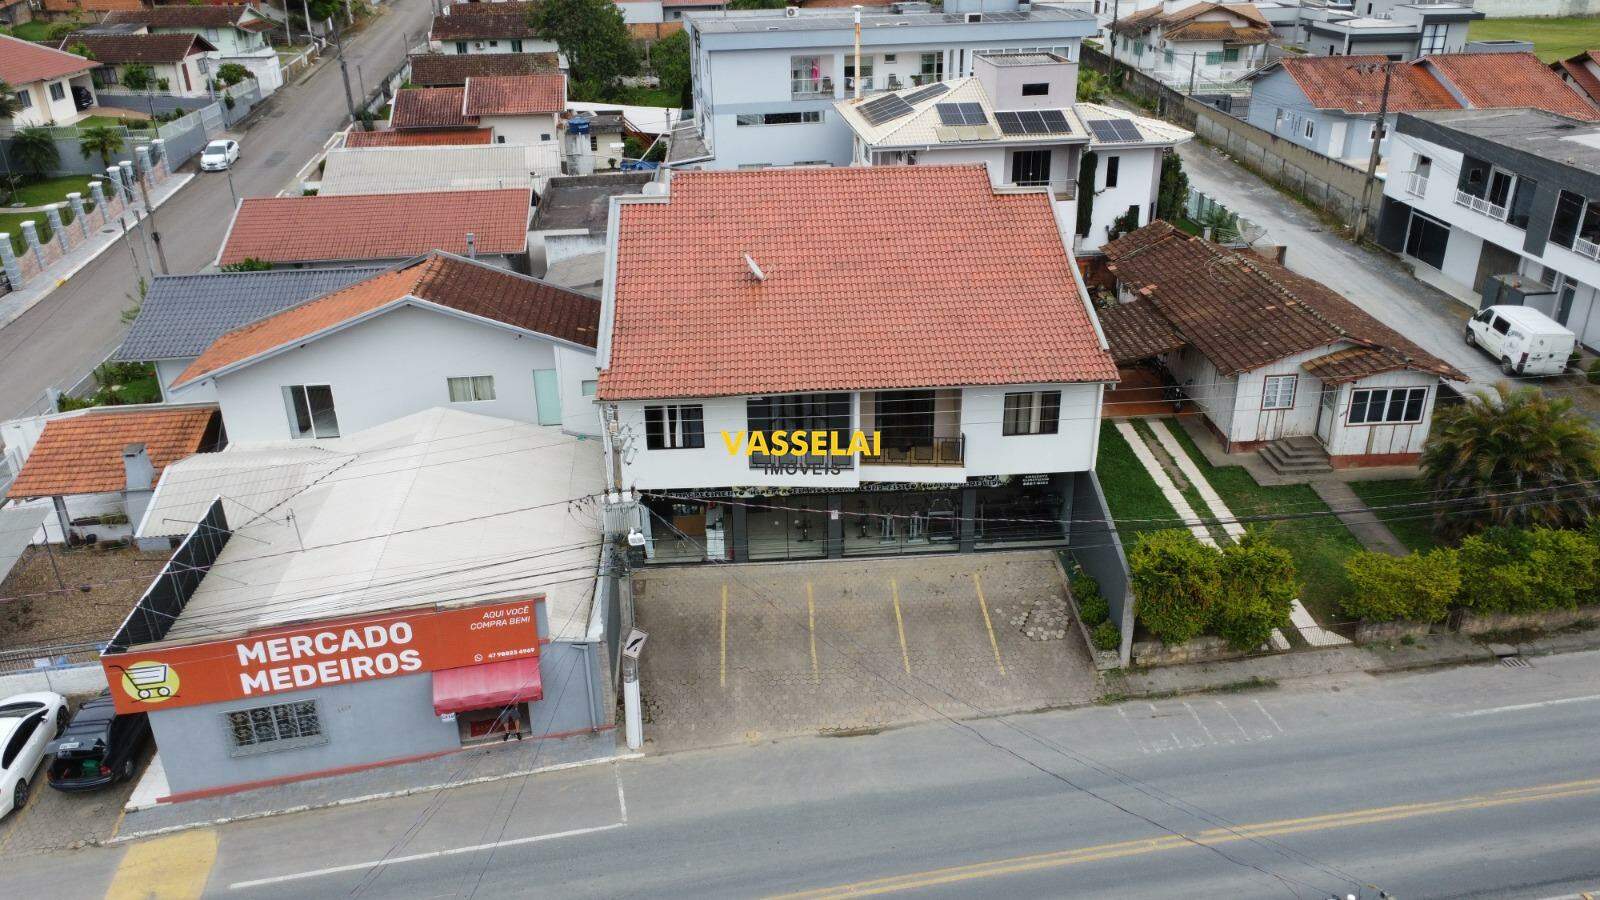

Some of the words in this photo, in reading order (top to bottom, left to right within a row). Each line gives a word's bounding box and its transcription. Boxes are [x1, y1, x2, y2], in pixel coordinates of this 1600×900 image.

[470, 619, 507, 630] COMPRA
[509, 615, 531, 625] BEM!
[483, 609, 504, 620] AQUI
[506, 606, 530, 616] VOCÊ
[236, 622, 413, 666] MERCADO
[240, 649, 423, 695] MEDEIROS
